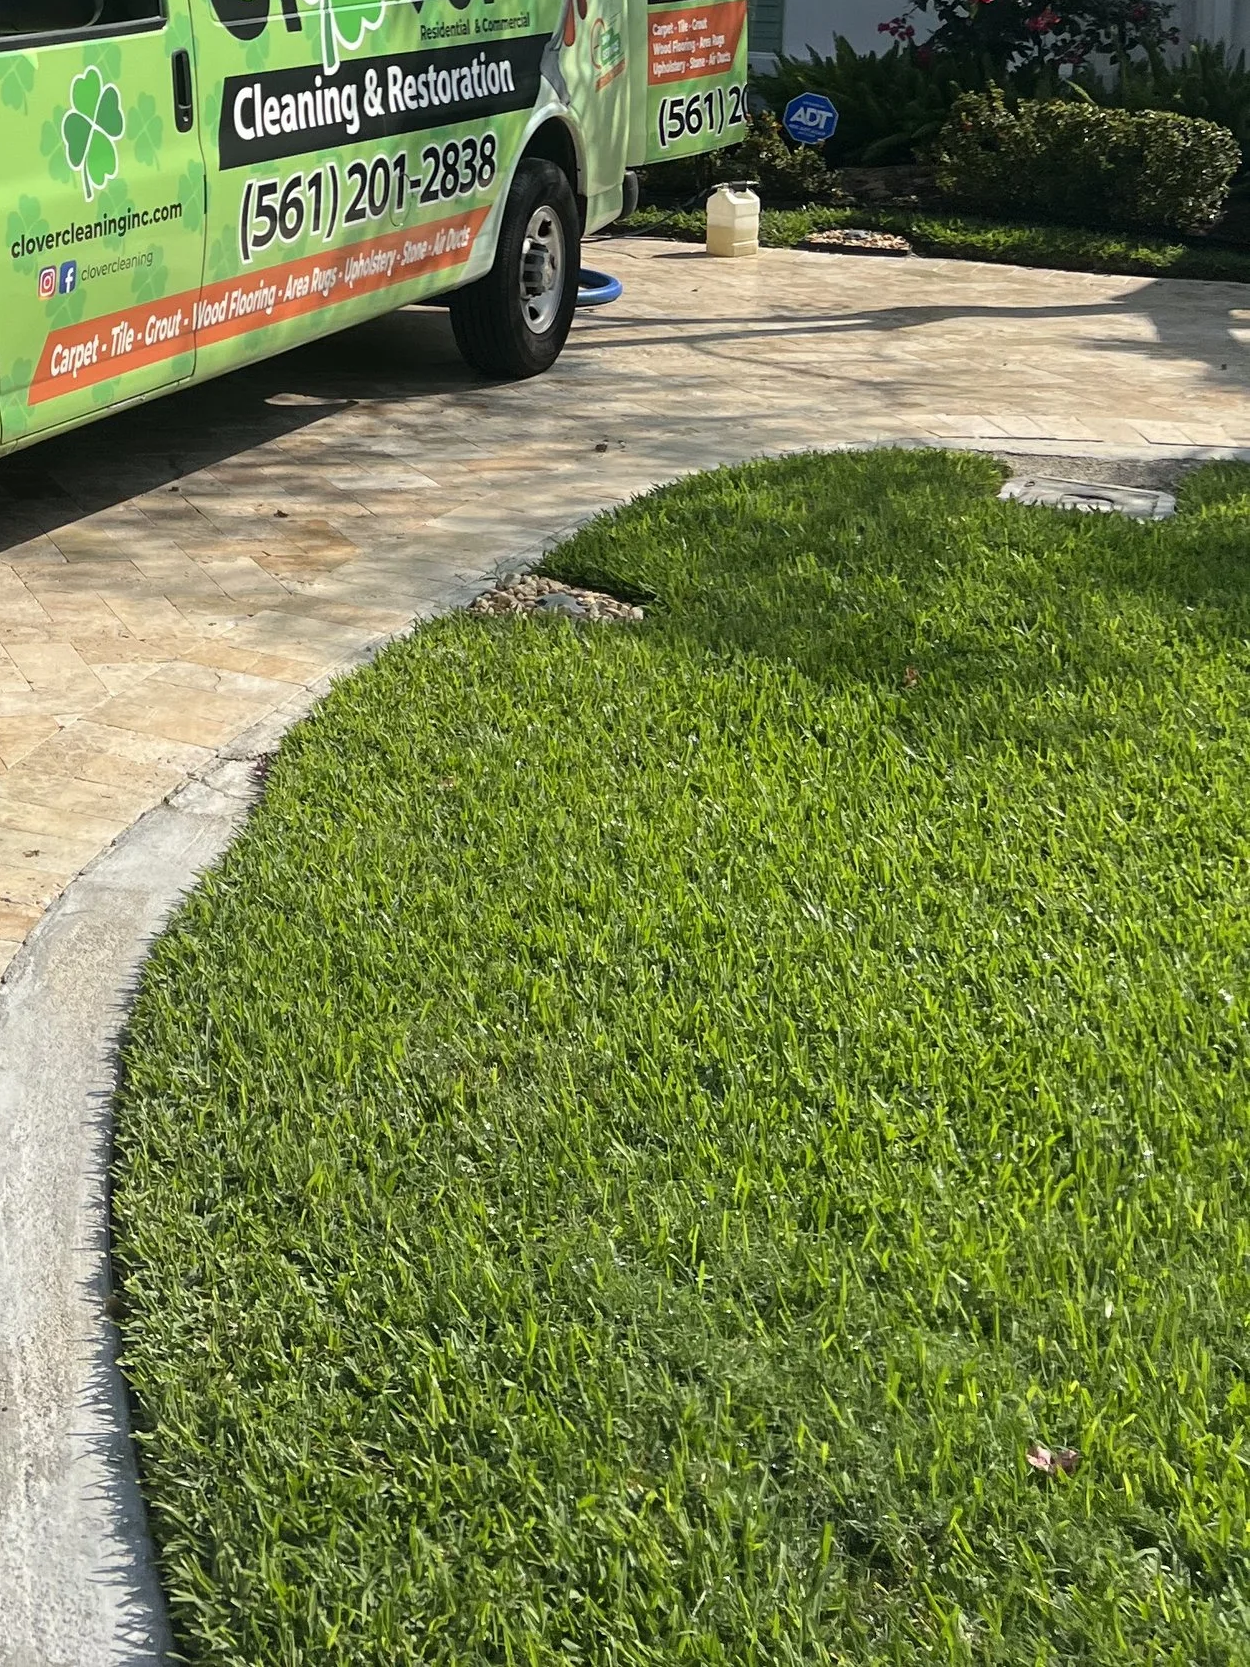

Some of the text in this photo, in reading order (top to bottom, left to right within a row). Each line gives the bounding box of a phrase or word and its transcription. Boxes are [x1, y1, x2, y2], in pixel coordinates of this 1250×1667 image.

[420, 12, 530, 40] Residential & Commercial
[233, 51, 516, 140] Cleaning & Restoration
[658, 88, 725, 147] (561)
[790, 106, 833, 129] ADT
[239, 133, 498, 262] (561) 201-2838
[11, 202, 182, 258] clovercleaninginc.com
[81, 251, 154, 281] clovercleaning
[50, 334, 99, 378] Carpet
[111, 321, 134, 357] Tile
[145, 309, 181, 345] Grout
[192, 292, 228, 330] Wood
[228, 279, 276, 314] Flooring
[283, 274, 309, 302] Area
[310, 267, 338, 297] Rugs
[344, 250, 396, 288] Upholstery
[401, 239, 427, 266] Stone
[432, 229, 448, 256] Air
[449, 225, 470, 253] Ducts
